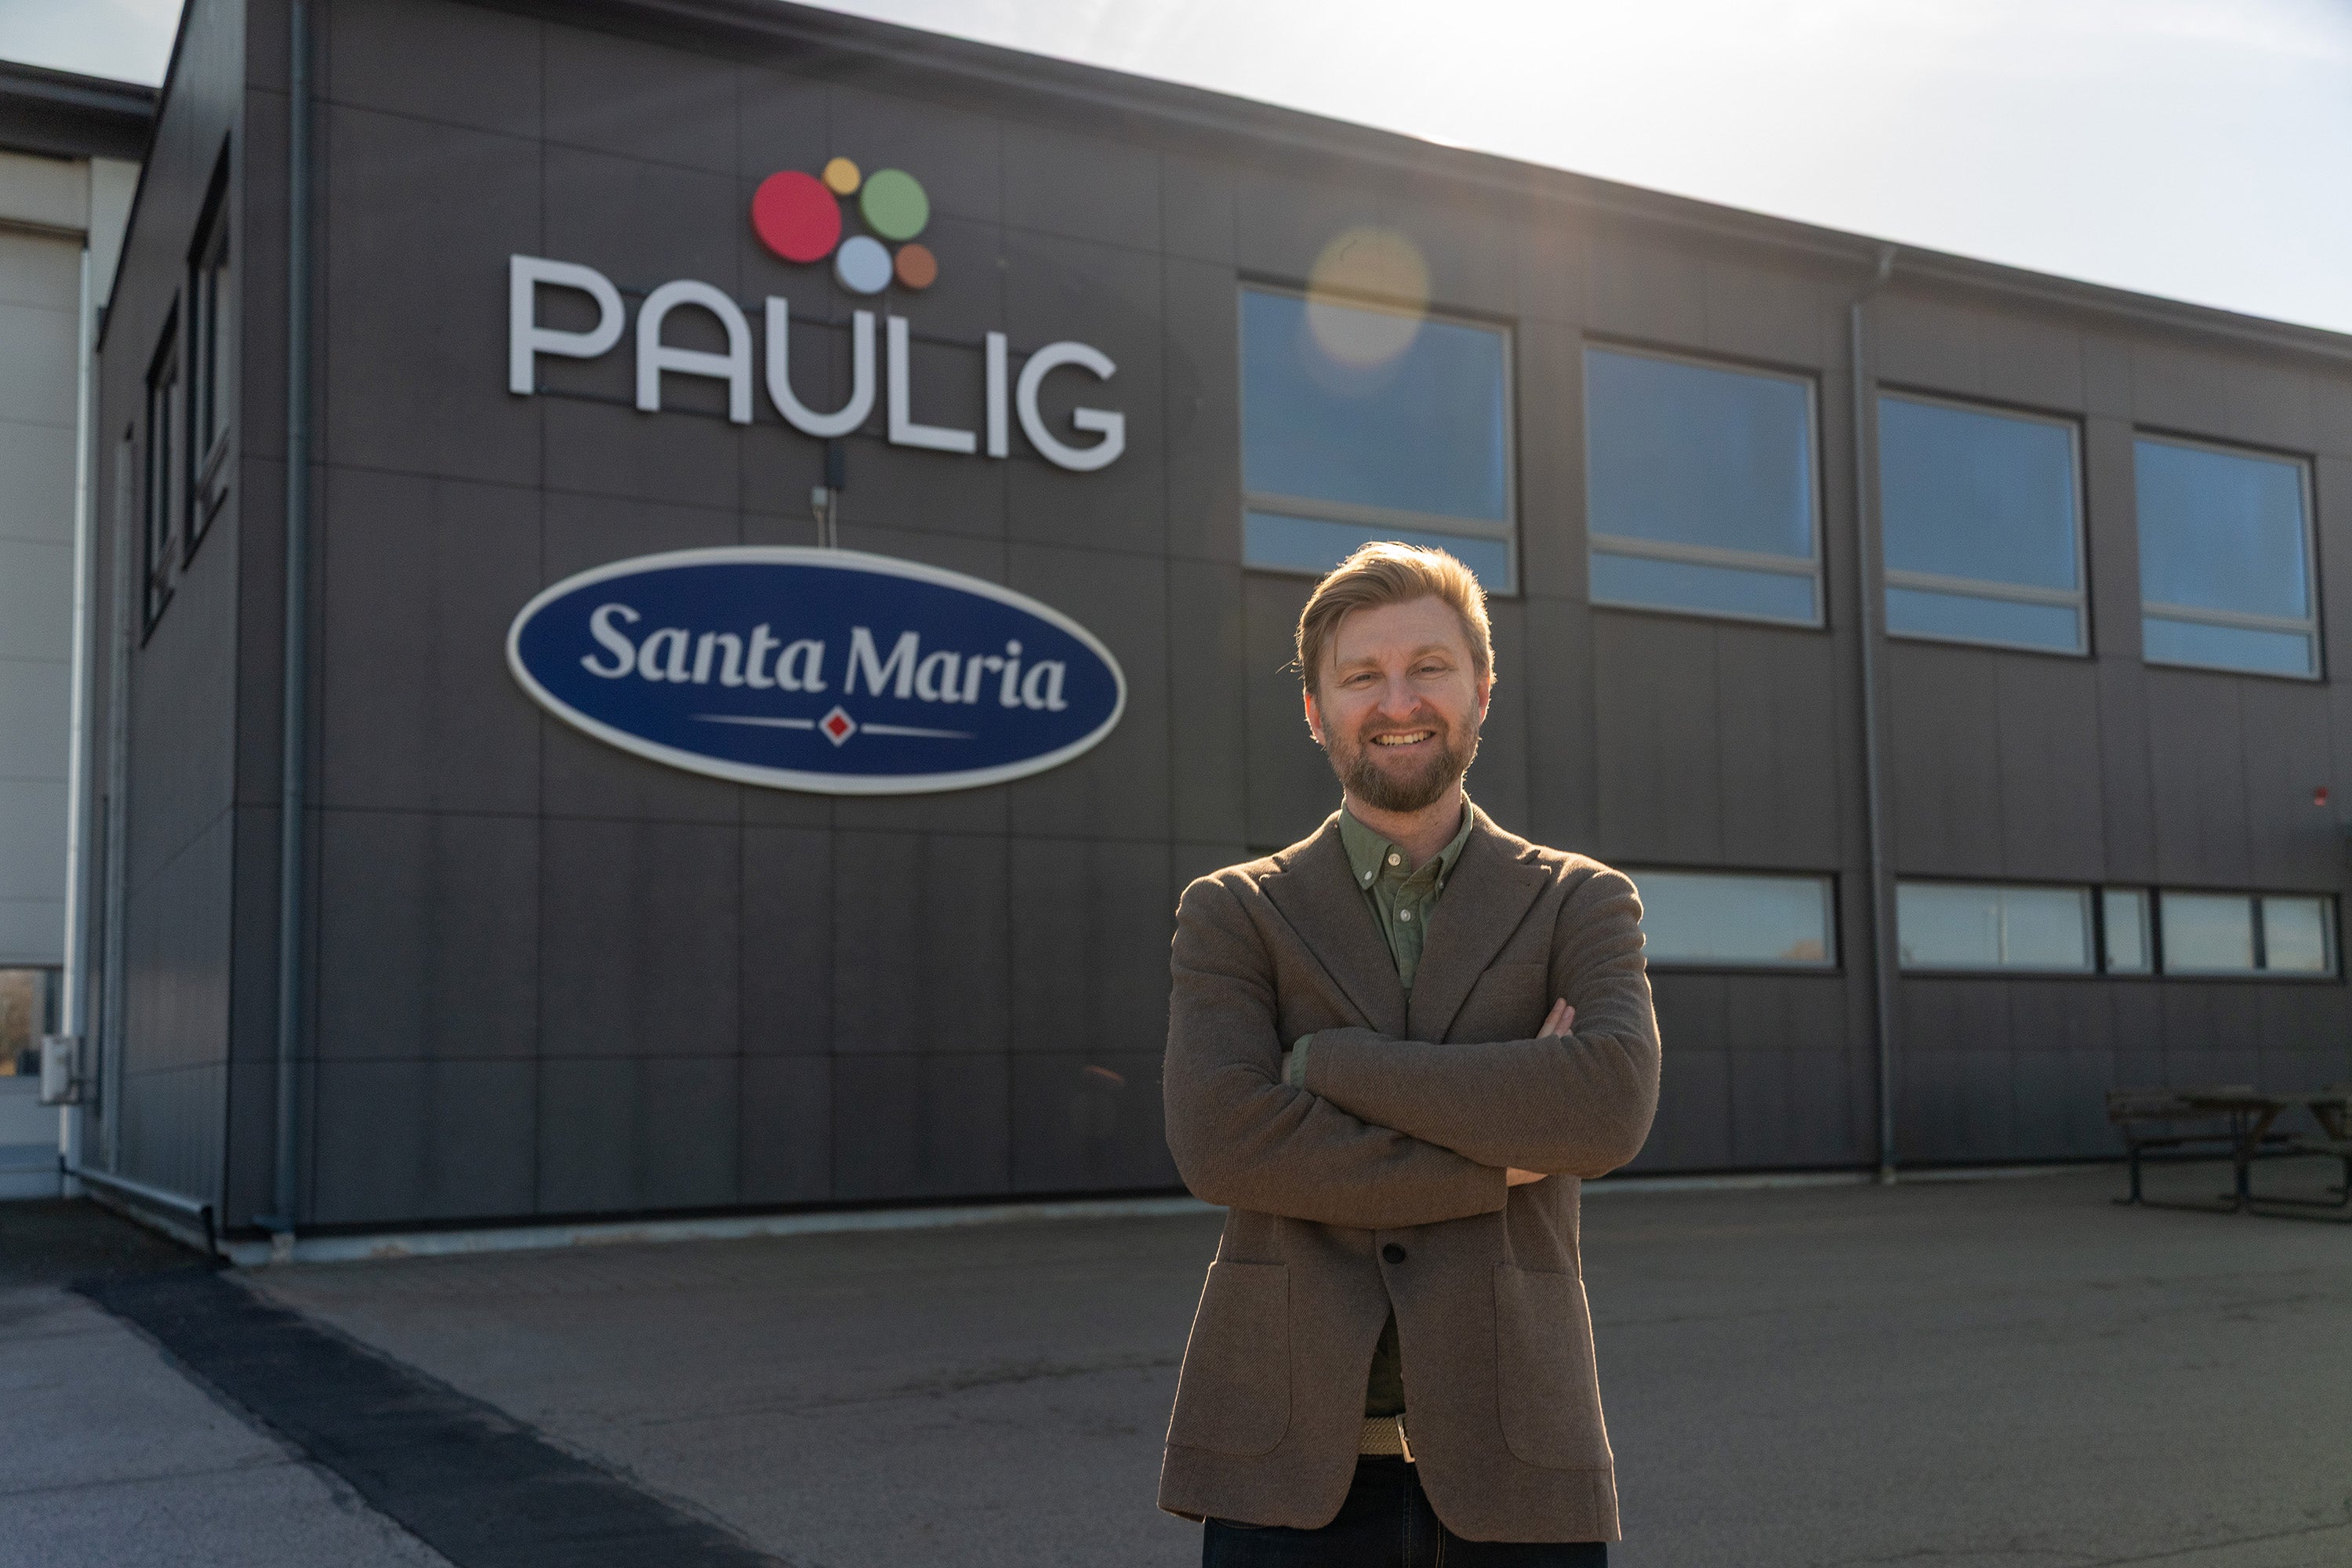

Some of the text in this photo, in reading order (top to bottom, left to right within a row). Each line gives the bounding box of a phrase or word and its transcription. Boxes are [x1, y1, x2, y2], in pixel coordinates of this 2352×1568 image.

[509, 254, 1125, 470] PAULIG
[580, 602, 1068, 712] Santa Maria
